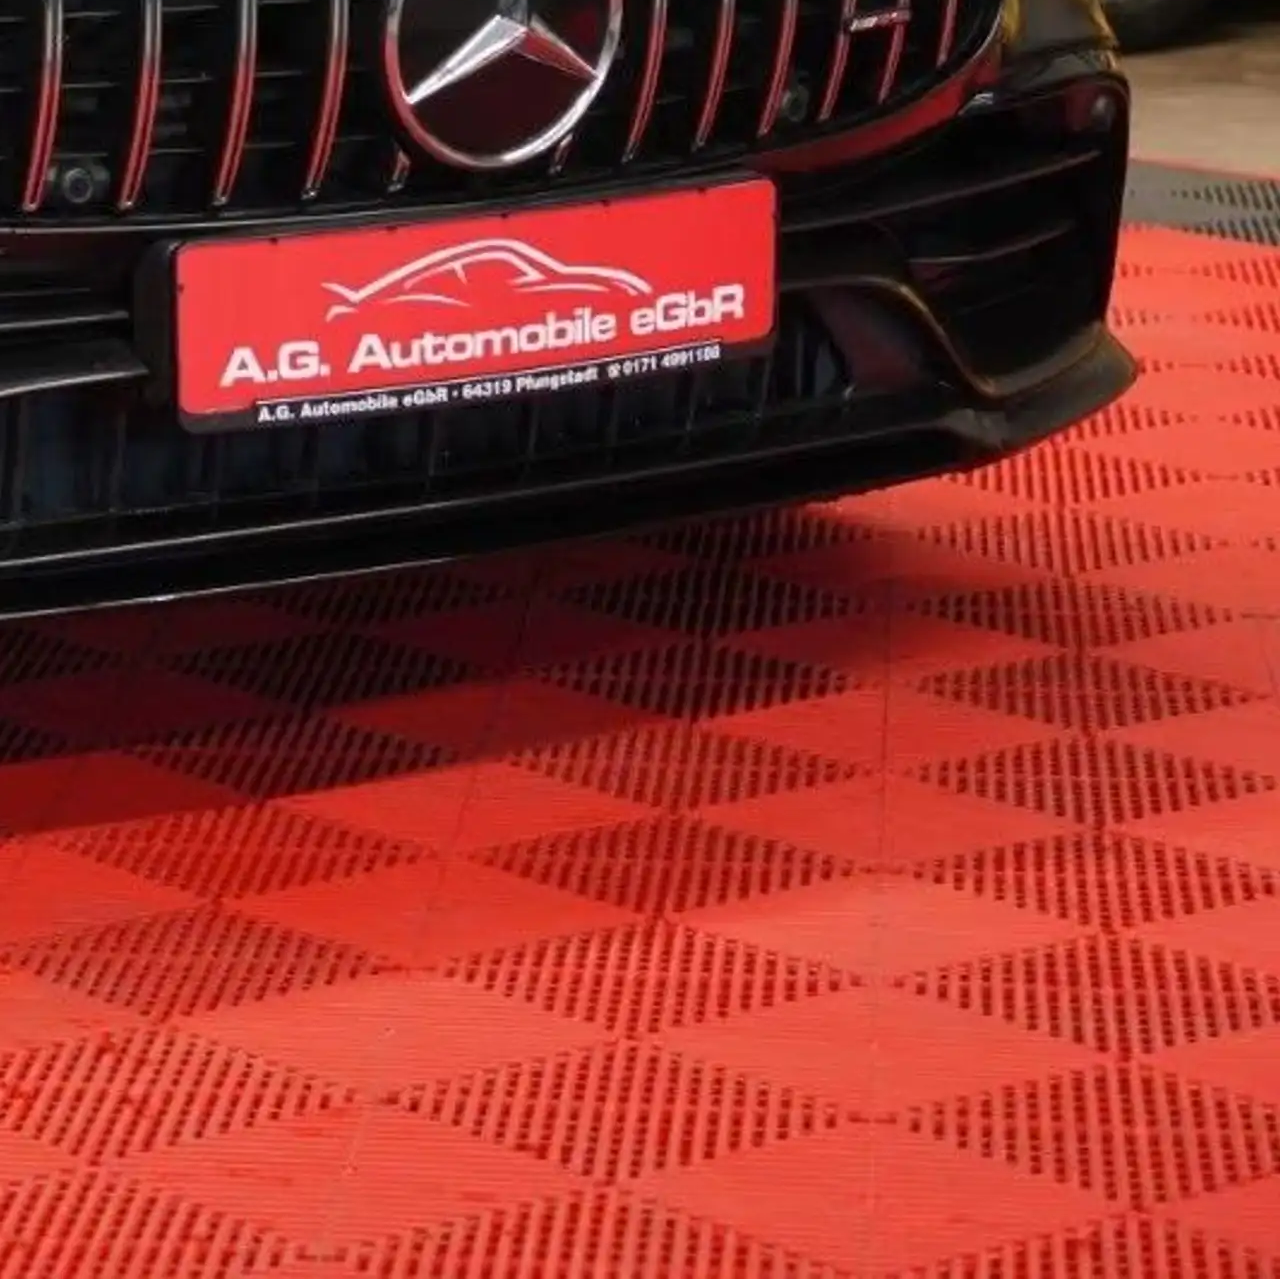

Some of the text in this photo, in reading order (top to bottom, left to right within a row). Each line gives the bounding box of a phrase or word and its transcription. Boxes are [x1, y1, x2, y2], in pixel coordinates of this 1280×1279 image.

[220, 283, 745, 388] A.G. Automobile eGbR
[257, 404, 295, 422] A.G.
[300, 393, 400, 418] Automobile
[402, 386, 449, 407] eGbR
[461, 379, 512, 400] 64319
